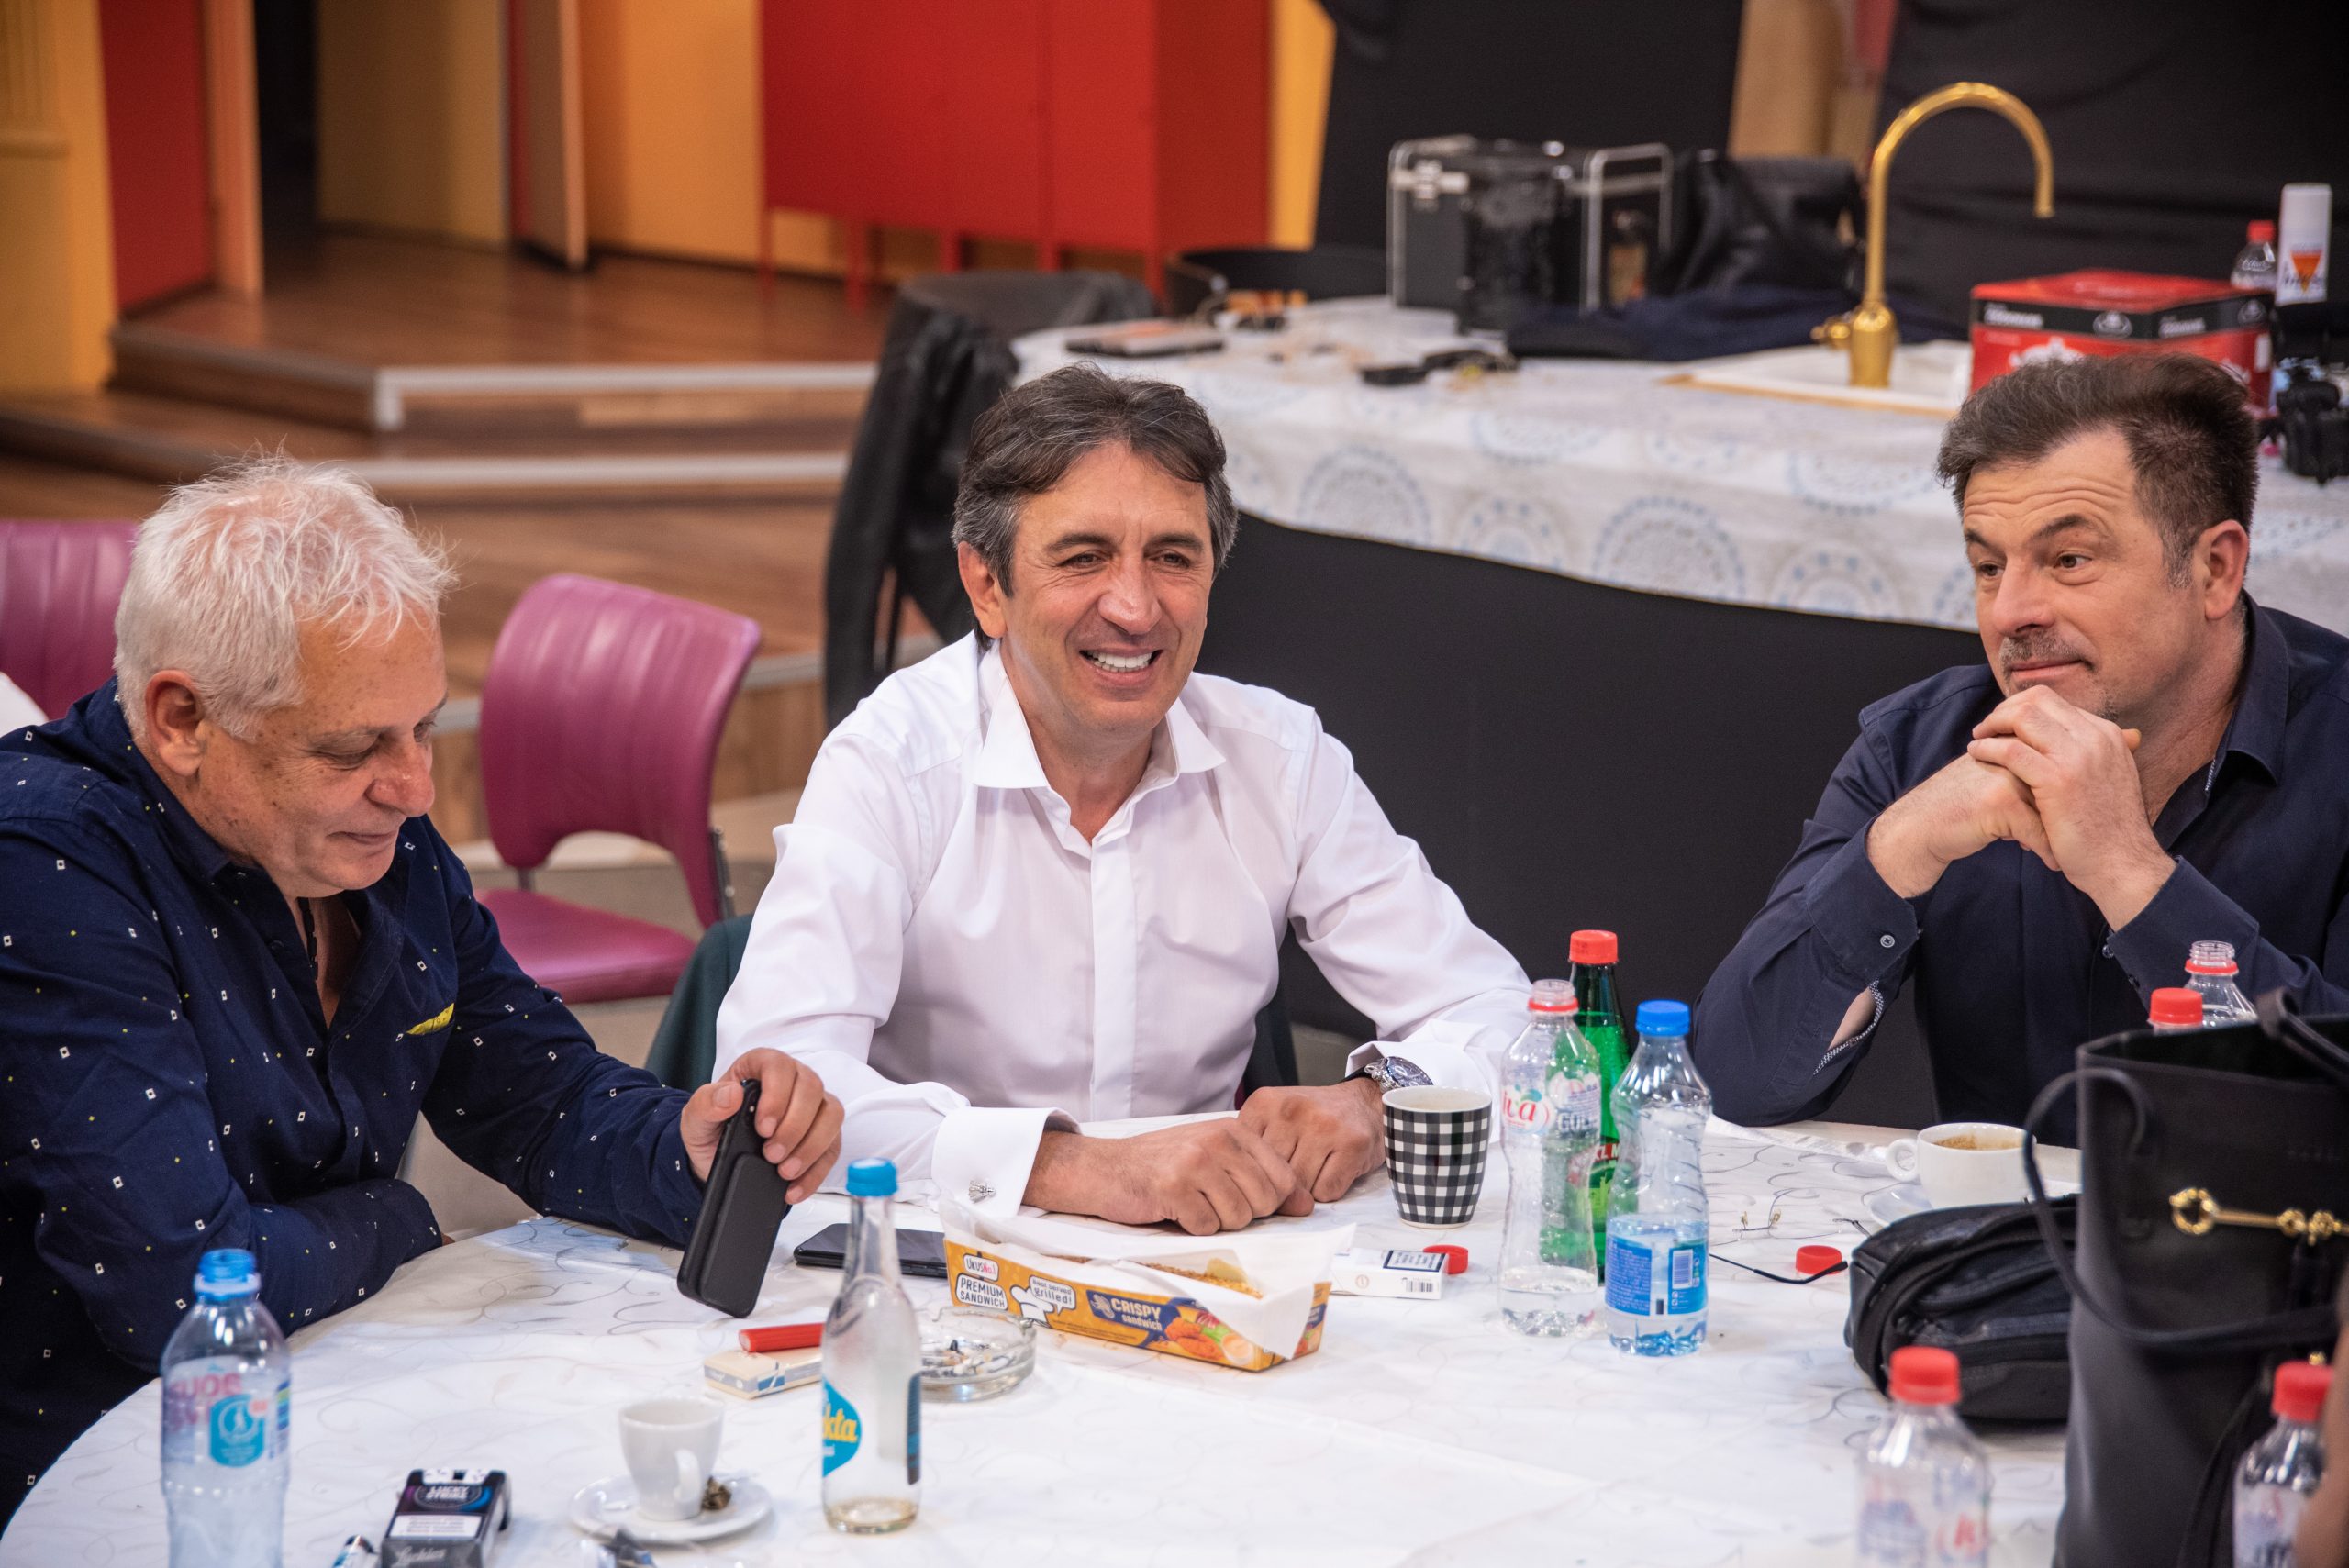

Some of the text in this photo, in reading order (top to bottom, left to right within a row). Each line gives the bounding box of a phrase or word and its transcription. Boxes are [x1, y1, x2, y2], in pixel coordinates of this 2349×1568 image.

[961, 1277, 1004, 1298] PREMIUM
[960, 1290, 1005, 1307] SANDWICH
[1110, 1297, 1161, 1319] CRISPY
[1121, 1314, 1163, 1331] sandwich
